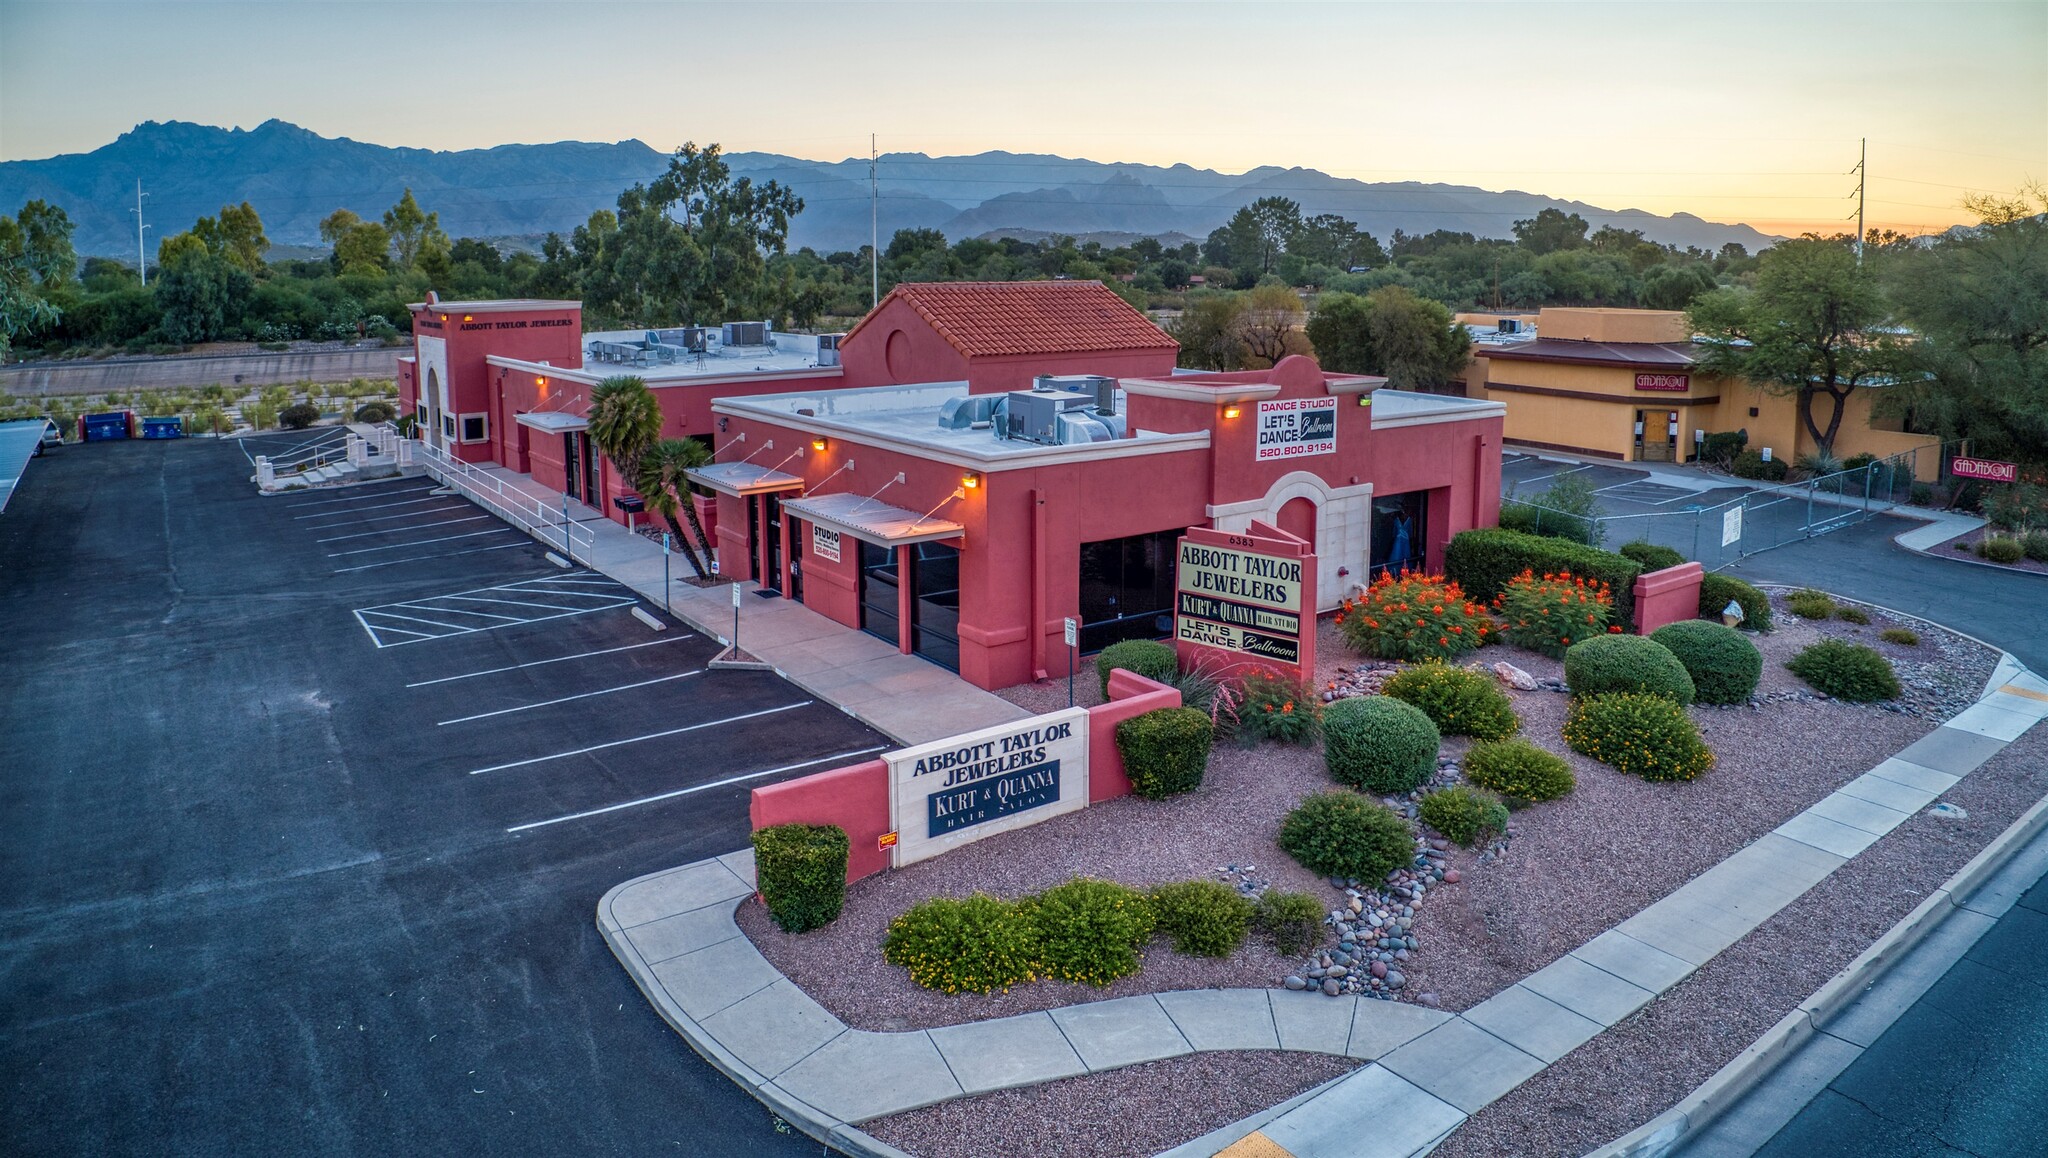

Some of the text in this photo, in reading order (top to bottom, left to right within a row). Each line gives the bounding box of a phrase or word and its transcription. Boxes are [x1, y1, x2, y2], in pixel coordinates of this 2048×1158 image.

[459, 319, 573, 331] ABBOTT TAYLOR JEWELERS
[1636, 374, 1687, 388] GADABOUT
[1261, 399, 1335, 412] DANCE STUDIO
[1264, 414, 1295, 429] LET'S
[1300, 416, 1333, 438] Ballroom
[1260, 429, 1298, 445] DANCE
[1260, 443, 1333, 458] 520.800.9194
[1953, 459, 2016, 478] GADABOUT
[814, 526, 839, 543] STUDIO
[1229, 536, 1254, 547] 6383
[1181, 546, 1301, 583] ABBOTT TAYLOR
[1192, 570, 1287, 604] JEWELERS
[1182, 594, 1297, 630] KURT & QUANNA HAIR STUDIO
[1186, 619, 1231, 637] LET'S
[1180, 629, 1237, 648] DANCE
[1242, 635, 1297, 658] Ballroom
[913, 722, 1072, 777] ABBOTT TAYLOR
[943, 747, 1047, 787] JEWELERS
[935, 769, 1055, 818] KURT & QUANNA
[947, 793, 1046, 828] HAIR SALON
